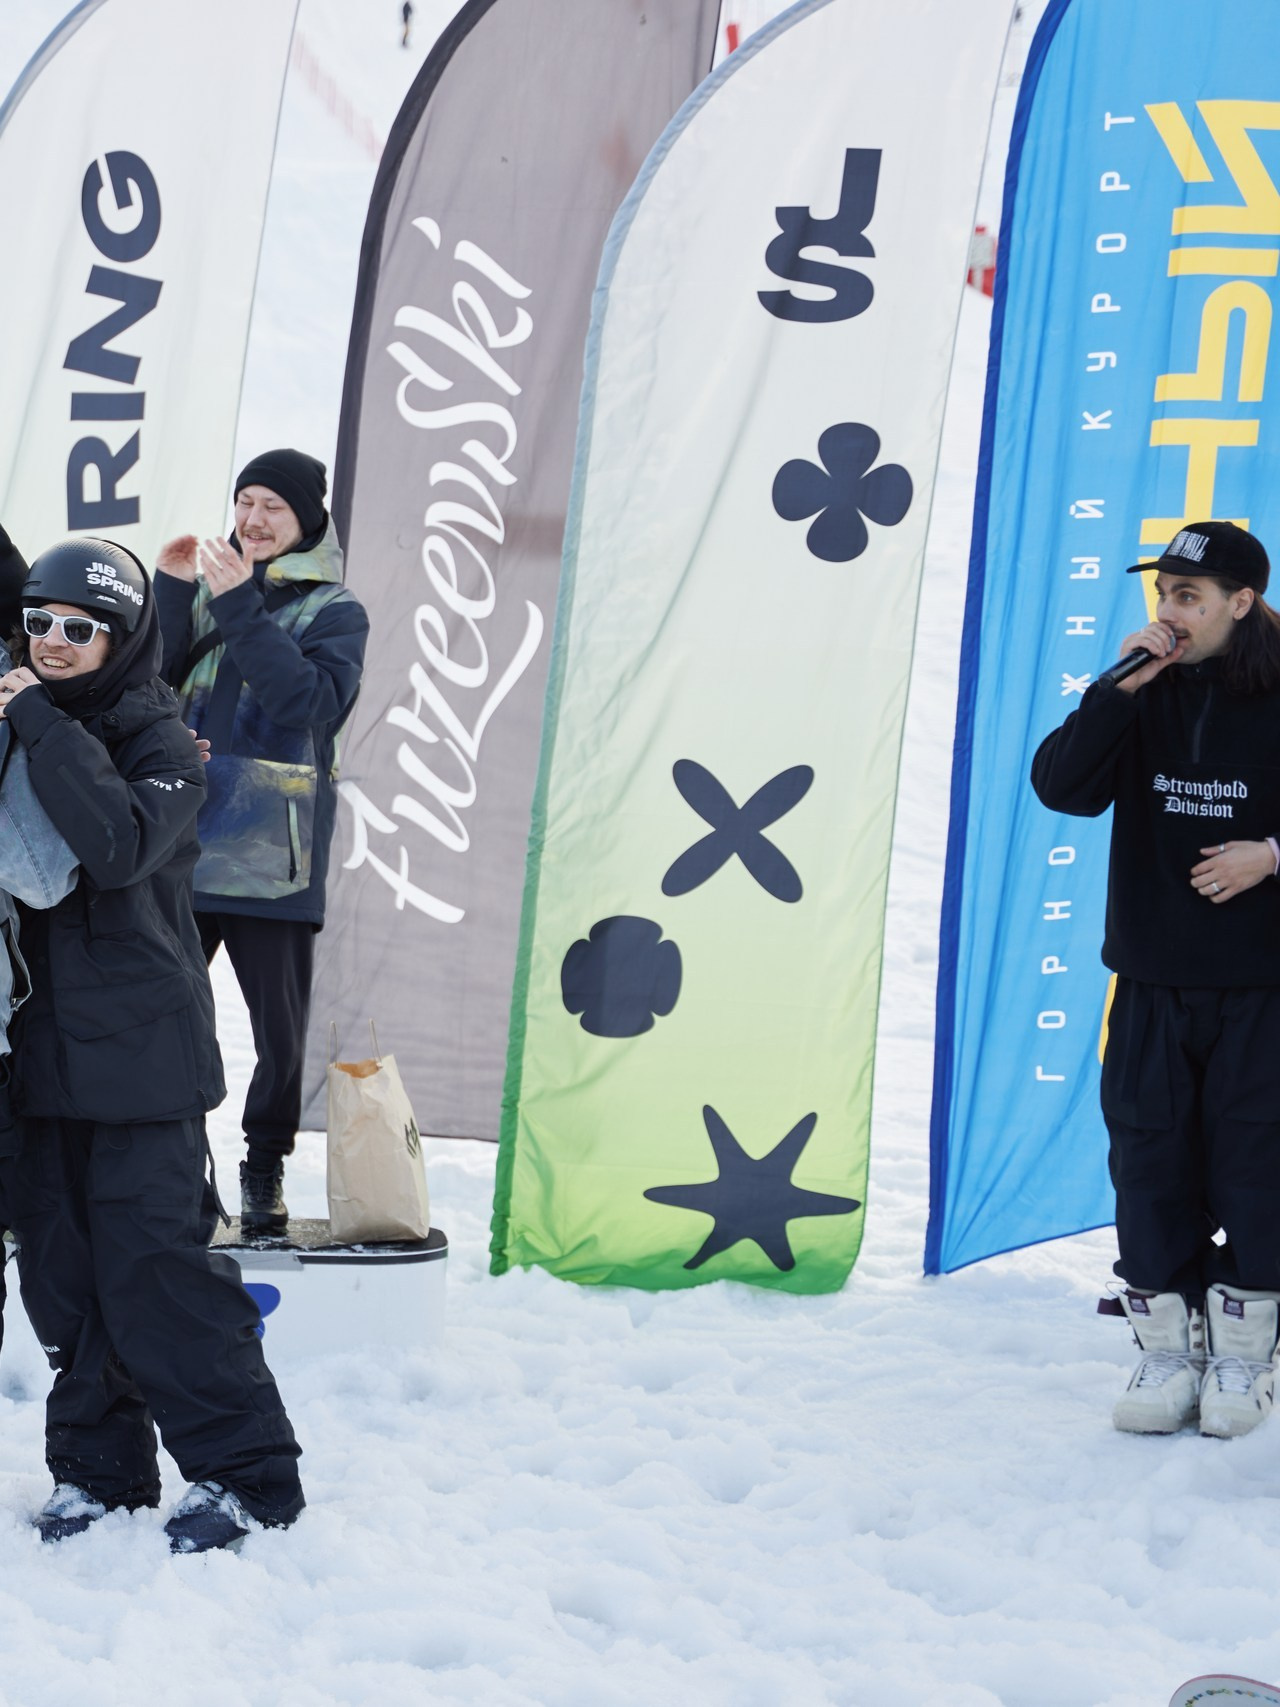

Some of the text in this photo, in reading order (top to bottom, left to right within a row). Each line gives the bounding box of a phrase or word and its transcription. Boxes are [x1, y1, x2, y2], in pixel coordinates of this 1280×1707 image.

[62, 149, 164, 531] RING
[85, 562, 117, 578] JIB
[86, 573, 144, 606] SPRING
[1035, 111, 1136, 1082] ГОРНОЖНЫЙ КУРОРТ
[1153, 773, 1248, 800] Stronghold
[1163, 796, 1234, 818] Division
